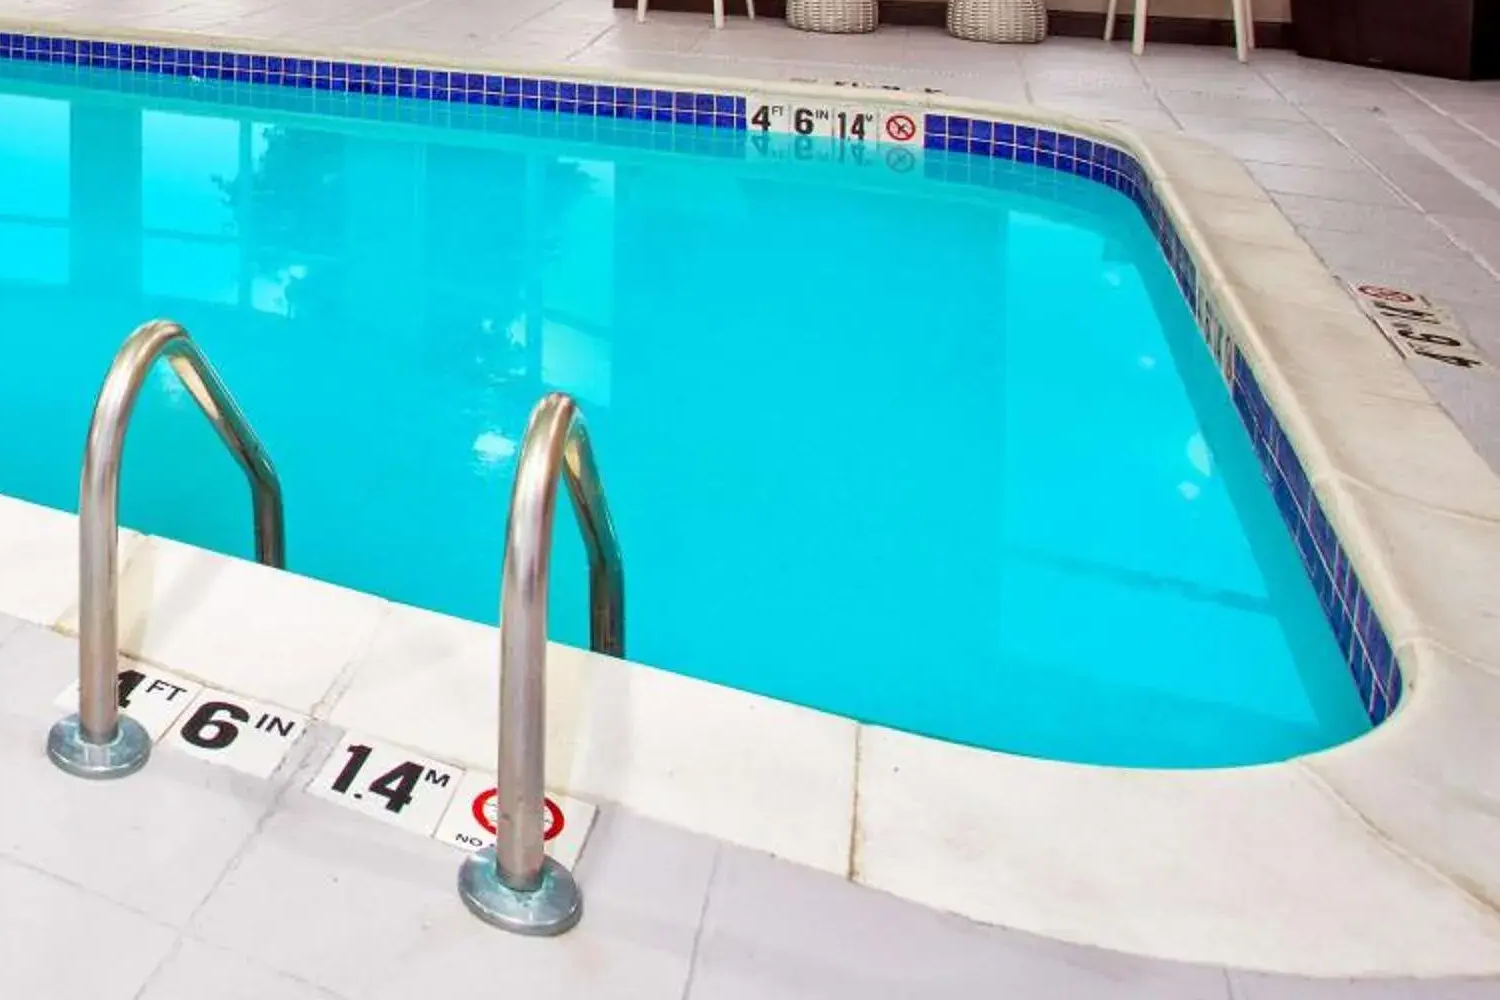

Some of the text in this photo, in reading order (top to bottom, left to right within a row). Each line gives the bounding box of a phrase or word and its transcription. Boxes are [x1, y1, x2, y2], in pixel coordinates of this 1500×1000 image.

[751, 105, 771, 132] 4
[794, 108, 814, 135] 6
[815, 110, 829, 120] IN
[145, 679, 188, 701] FT
[180, 701, 251, 750] 6
[254, 713, 295, 737] IN
[331, 744, 425, 814] 1.4
[424, 769, 451, 788] M
[455, 833, 483, 848] NO
